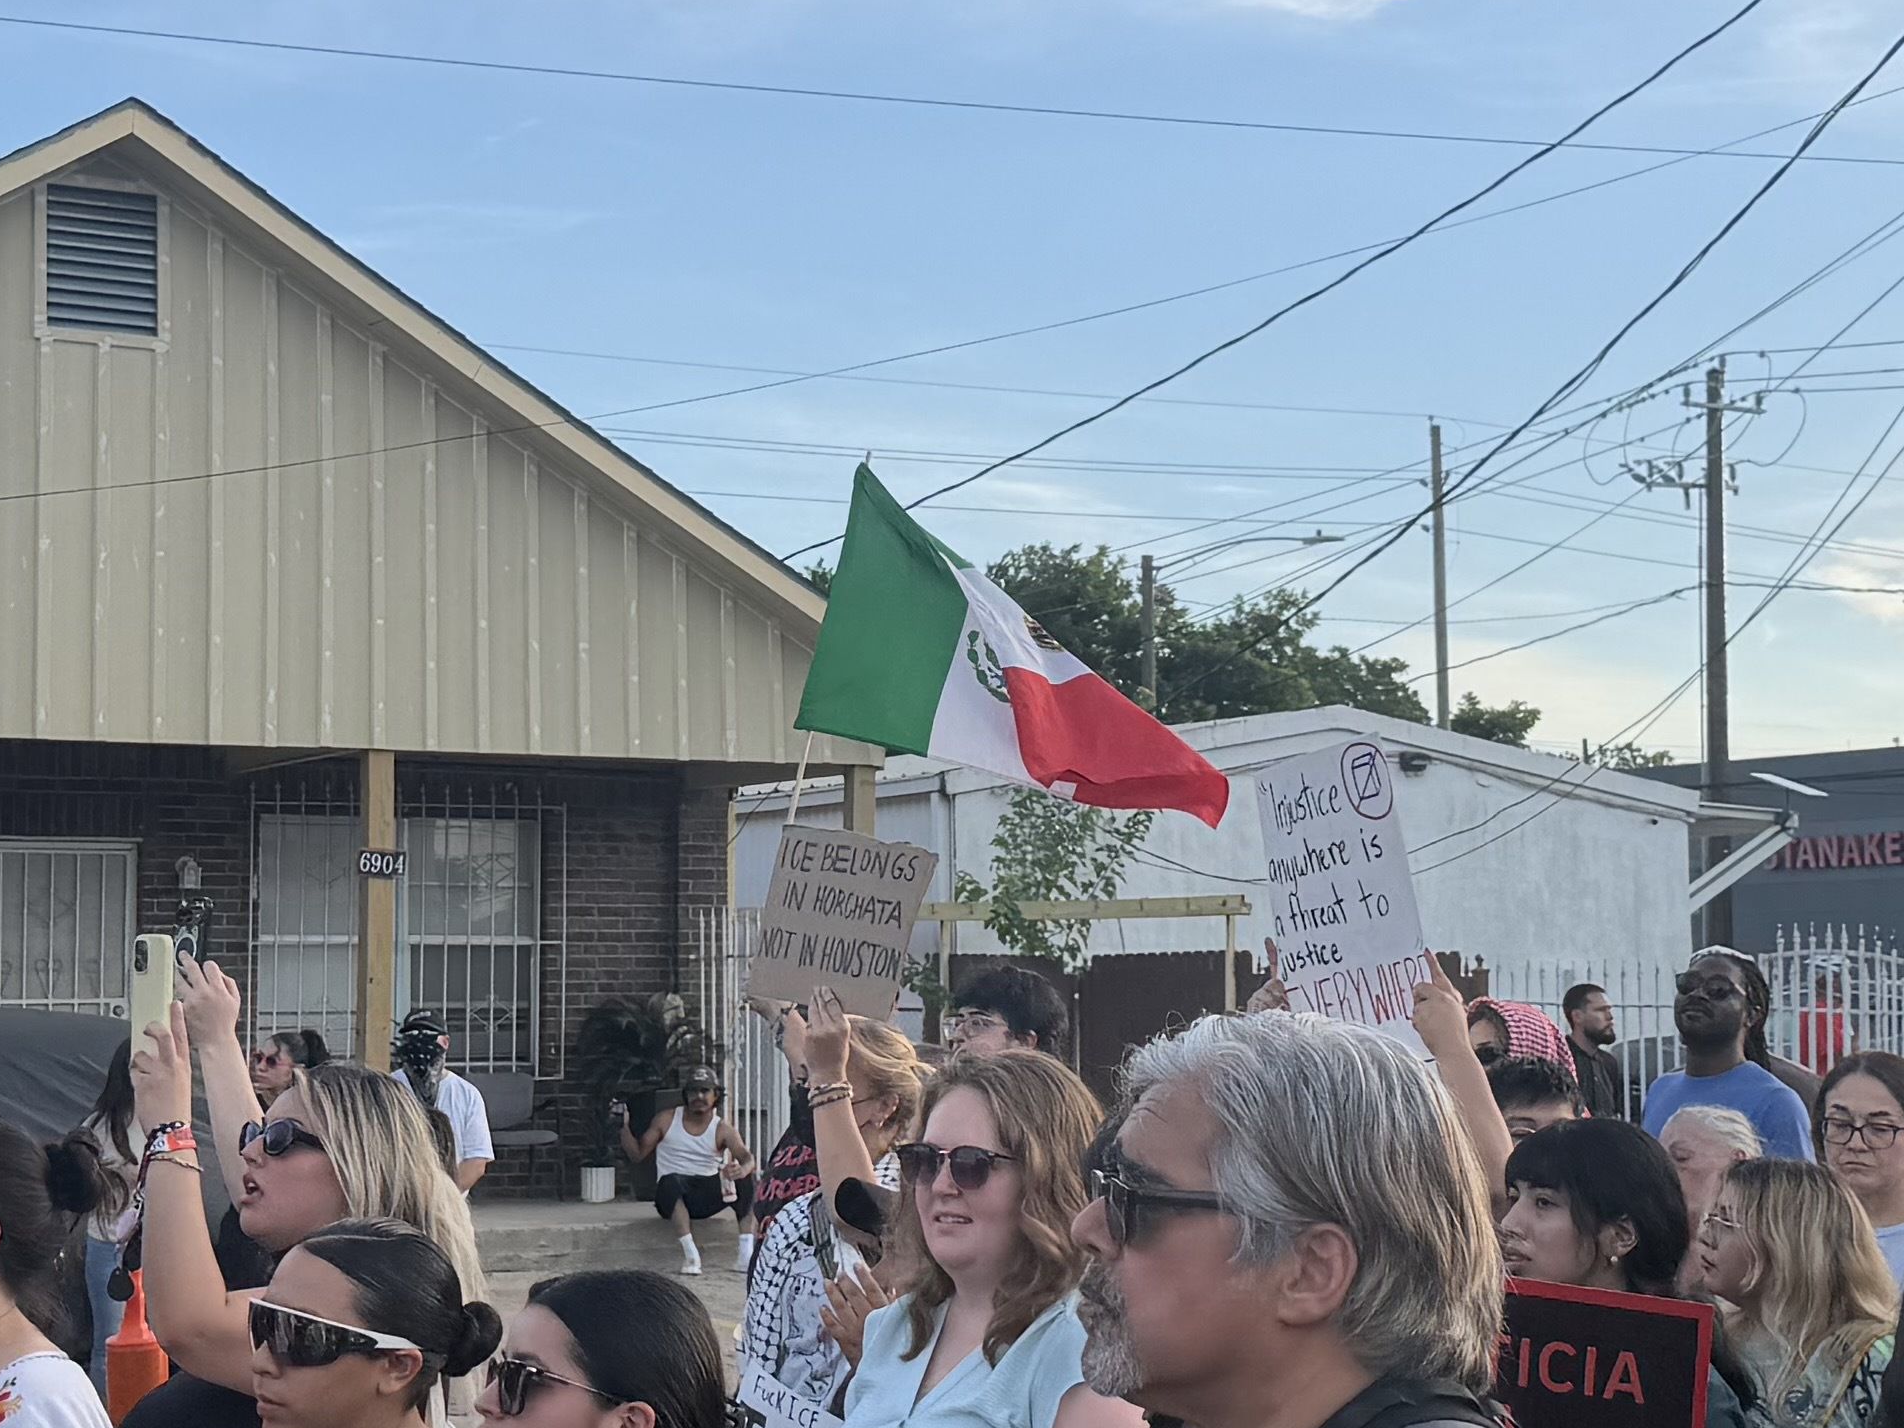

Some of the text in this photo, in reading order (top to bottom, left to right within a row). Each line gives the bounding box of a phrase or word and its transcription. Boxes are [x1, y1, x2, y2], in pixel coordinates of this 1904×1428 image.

[360, 852, 404, 874] 6904
[780, 838, 919, 882] ICE BELONGS
[1268, 828, 1384, 896] anywhere is
[782, 880, 902, 930] IN HORCHATA
[1288, 881, 1348, 933] threat
[1358, 878, 1390, 930] to
[757, 925, 901, 981] NOT IN HOUSTON
[1279, 940, 1343, 983] justice
